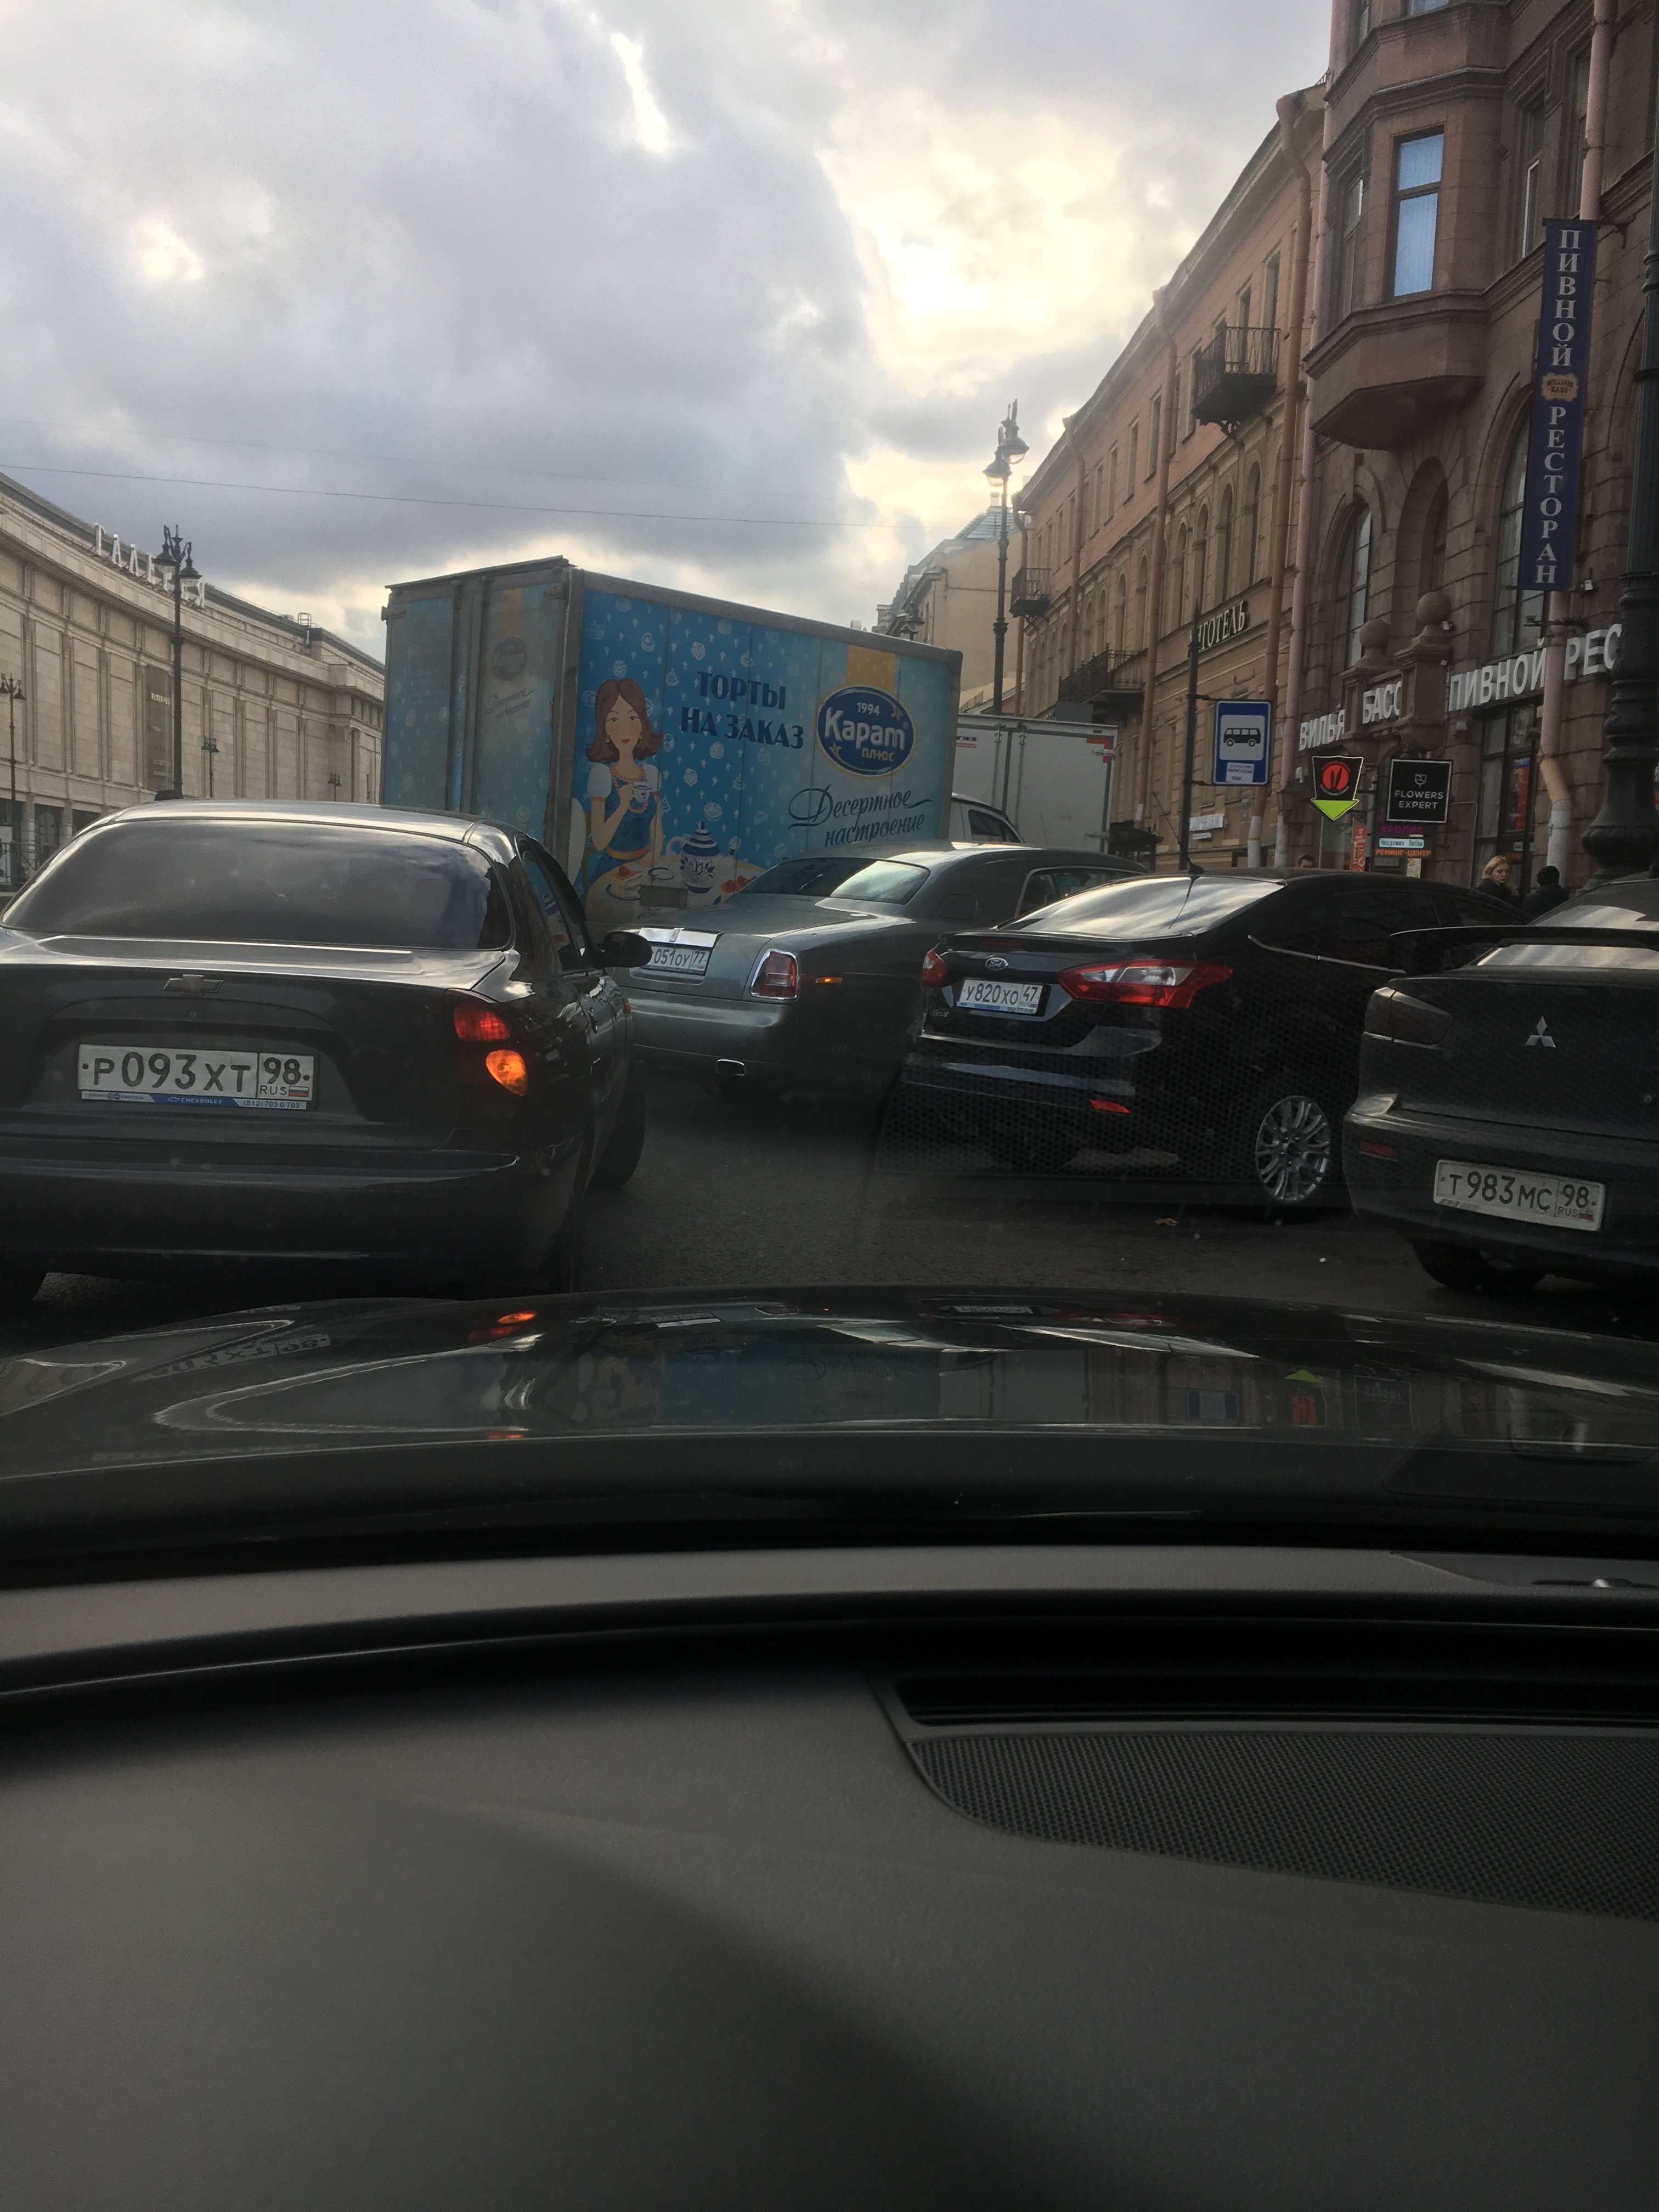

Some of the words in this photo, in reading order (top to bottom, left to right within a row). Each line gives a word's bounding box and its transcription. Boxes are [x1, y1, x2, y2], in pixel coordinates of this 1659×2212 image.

[1550, 229, 1582, 366] ПИВНОЙ
[1535, 406, 1566, 583] РЕСТОРАН
[94, 522, 205, 607] ГАЛЕЯ
[1448, 637, 1547, 712] ПИВНОЙ
[1564, 623, 1622, 680] РЕС
[697, 671, 786, 709] ТОРТЫ
[857, 702, 880, 715] 1994
[681, 707, 718, 736] НА
[725, 714, 804, 749] ЗАКАЗ
[825, 707, 905, 751] Карат
[1299, 709, 1345, 751] ВИЛЬЯ
[1362, 681, 1402, 724] БАСС
[788, 784, 933, 830] Десертное
[1395, 790, 1443, 799] FLOWERS
[1398, 801, 1438, 809] EXPERT
[825, 814, 925, 847] настроение
[1380, 825, 1423, 834] КРОЛИК
[651, 949, 690, 967] 051ОУ
[693, 951, 706, 964] 77
[966, 983, 1019, 1005] У820ХО
[1023, 986, 1039, 1002] 47
[94, 1052, 251, 1092] Р093ХТ
[264, 1057, 301, 1085] 98
[259, 1085, 287, 1096] RUS
[1449, 1171, 1552, 1210] Т983МС
[1562, 1184, 1589, 1208] 98
[1558, 1206, 1578, 1217] RUS
